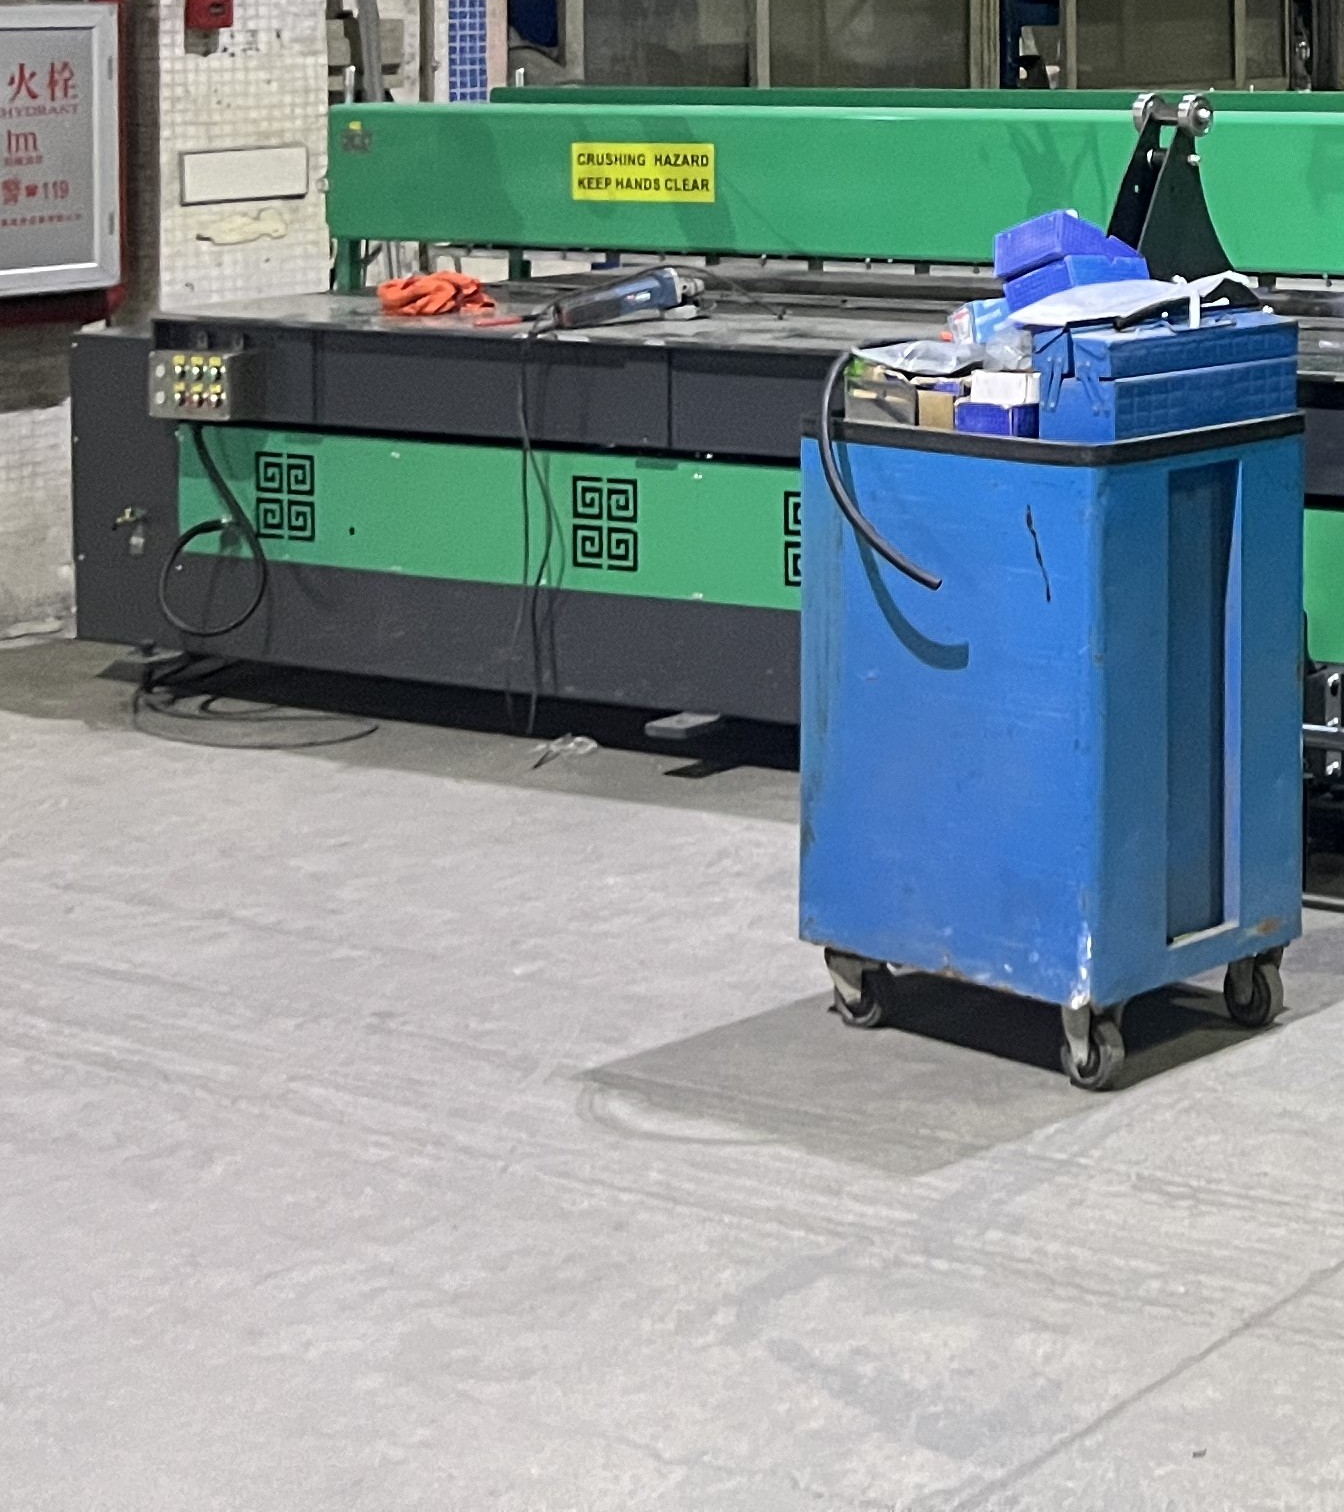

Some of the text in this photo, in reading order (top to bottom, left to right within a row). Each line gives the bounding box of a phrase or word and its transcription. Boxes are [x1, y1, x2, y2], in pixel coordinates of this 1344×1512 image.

[577, 153, 710, 168] CRUSHING HAZARD
[577, 177, 710, 192] KEEP HANDS CLEAR
